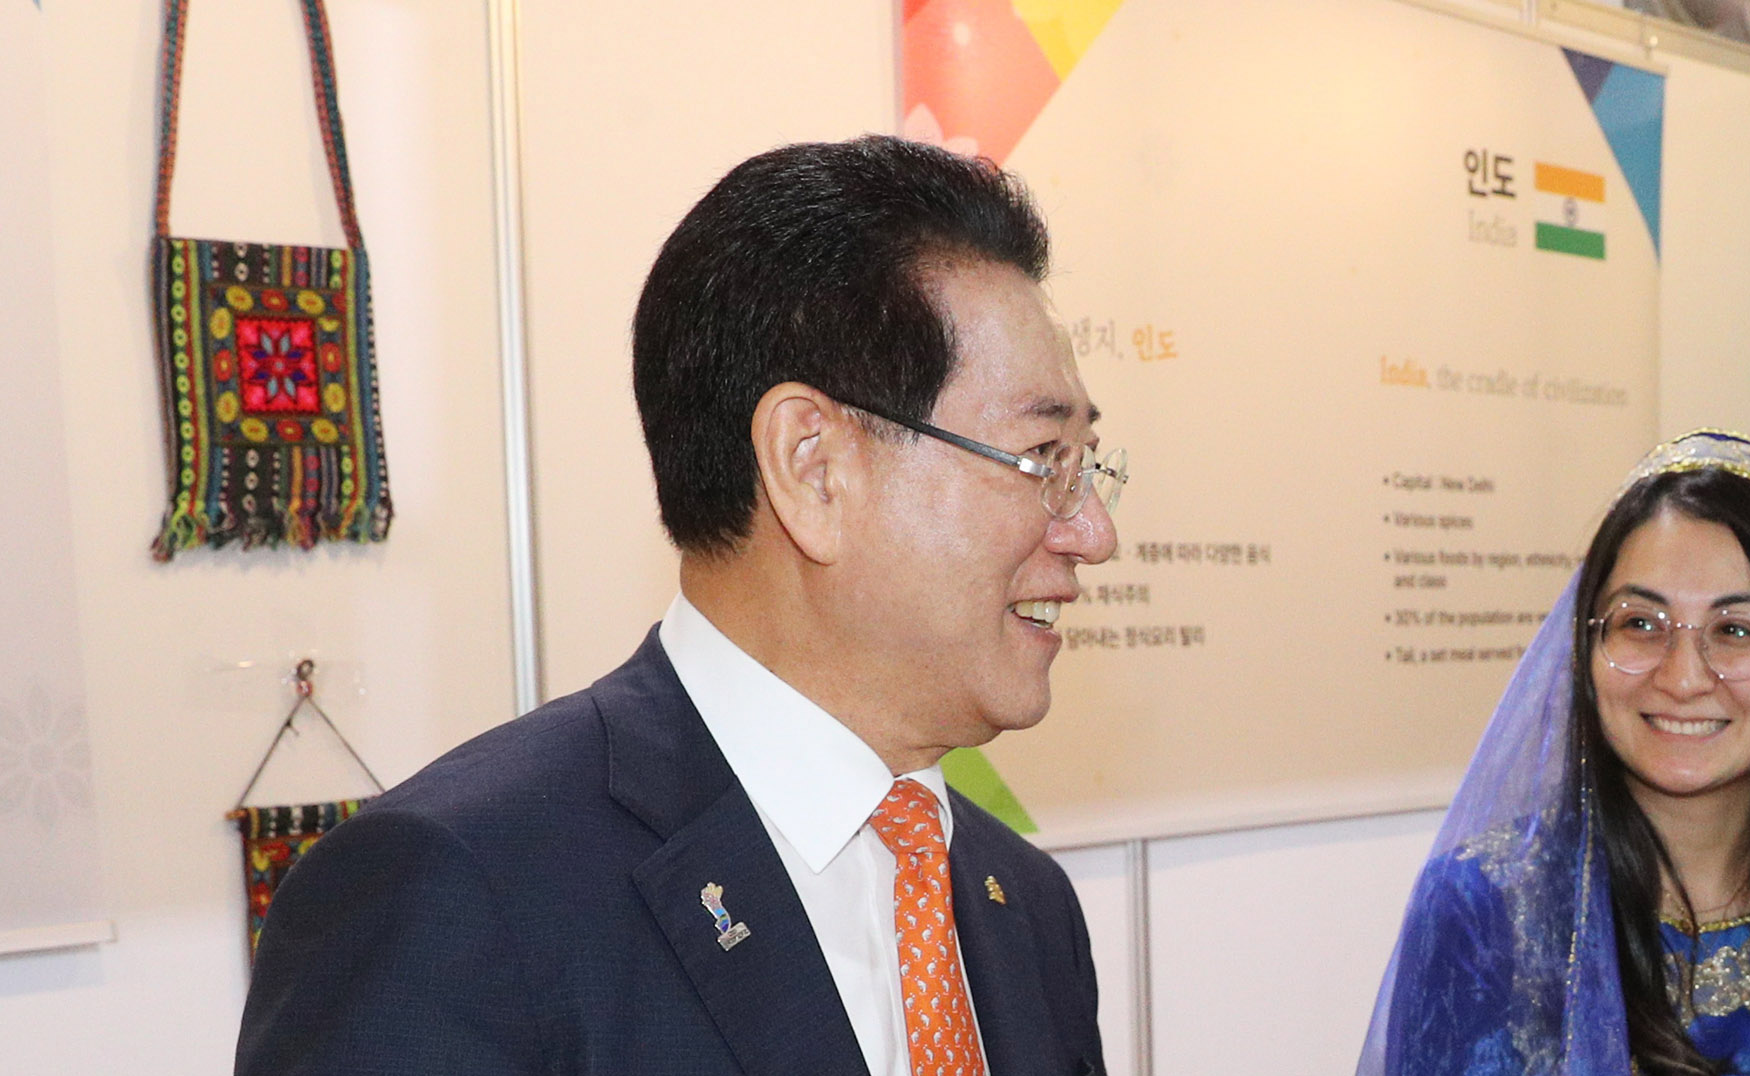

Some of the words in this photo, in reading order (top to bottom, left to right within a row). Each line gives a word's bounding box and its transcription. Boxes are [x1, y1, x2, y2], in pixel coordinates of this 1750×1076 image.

[1463, 148, 1517, 199] 인도
[1468, 208, 1517, 248] India
[1131, 323, 1179, 362] 인도
[1435, 363, 1463, 392] the
[1522, 371, 1540, 399] of
